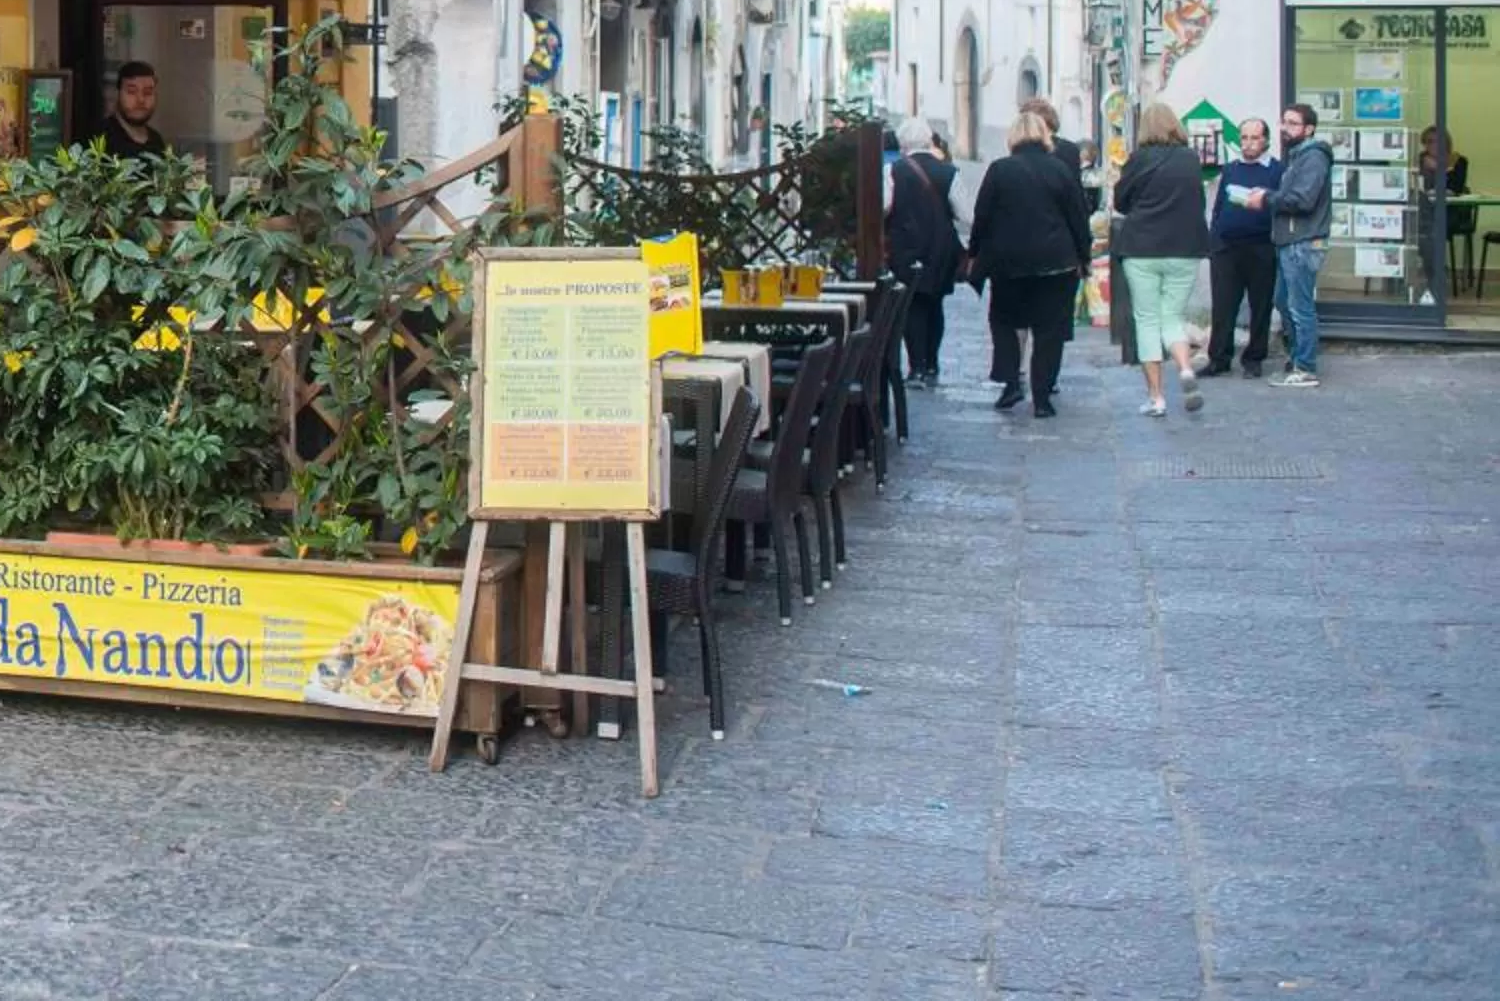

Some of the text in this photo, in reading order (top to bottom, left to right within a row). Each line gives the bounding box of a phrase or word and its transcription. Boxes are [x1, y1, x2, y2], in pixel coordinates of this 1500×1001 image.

[1373, 13, 1487, 39] TECNOASA
[564, 282, 642, 296] PROPOSTE
[142, 572, 243, 606] Pizzeria
[52, 601, 250, 685] Nando
